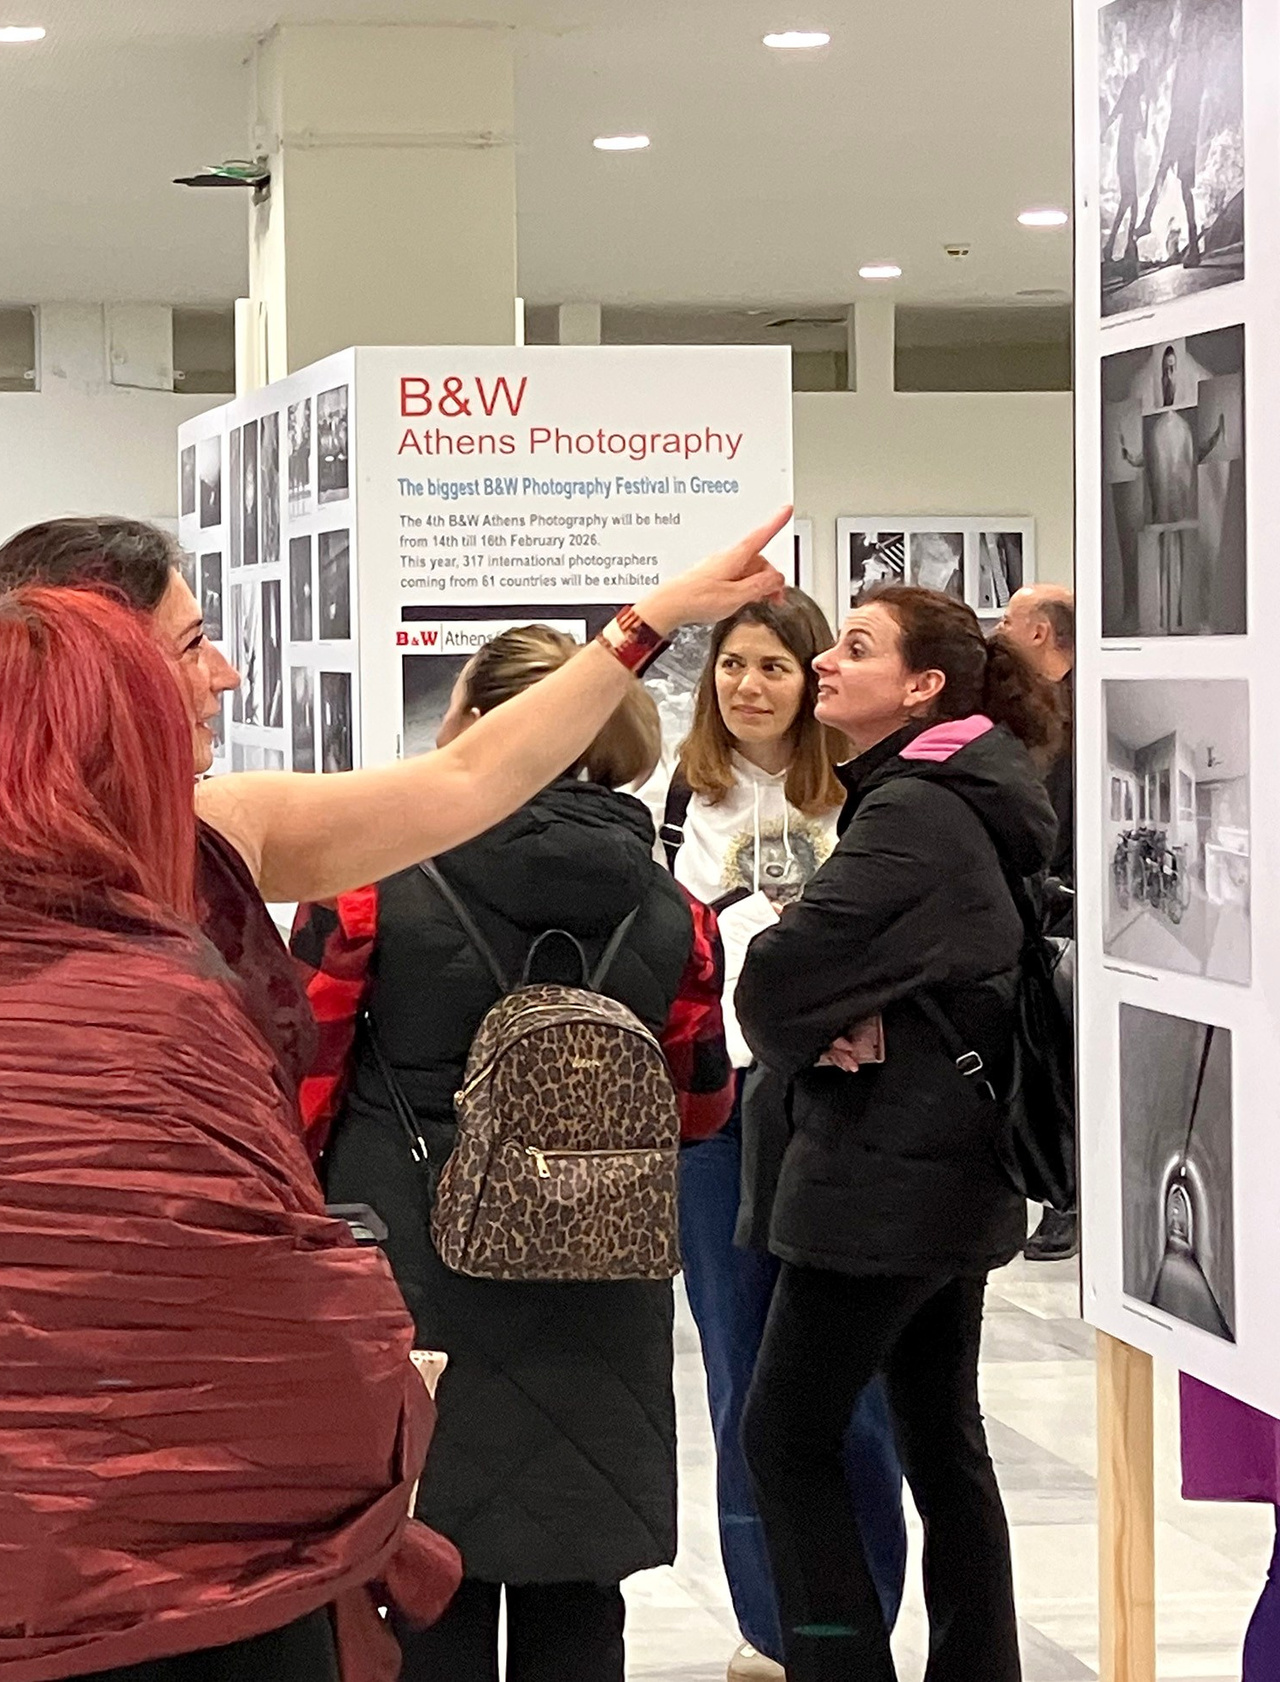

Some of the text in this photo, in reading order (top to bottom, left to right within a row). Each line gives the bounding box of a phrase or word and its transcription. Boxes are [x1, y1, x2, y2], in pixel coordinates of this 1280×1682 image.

[400, 376, 528, 417] B&W
[397, 427, 743, 460] Athens Photography
[397, 476, 739, 500] The biggest B&W Photography Festival in Greece
[400, 512, 681, 529] The 4th B&W Athens Photography will be held
[400, 533, 601, 549] from 14th till 16th February 2026.
[400, 554, 658, 570] This year, 317 international photographers
[400, 572, 660, 591] coming from 61 countries will be exhibited
